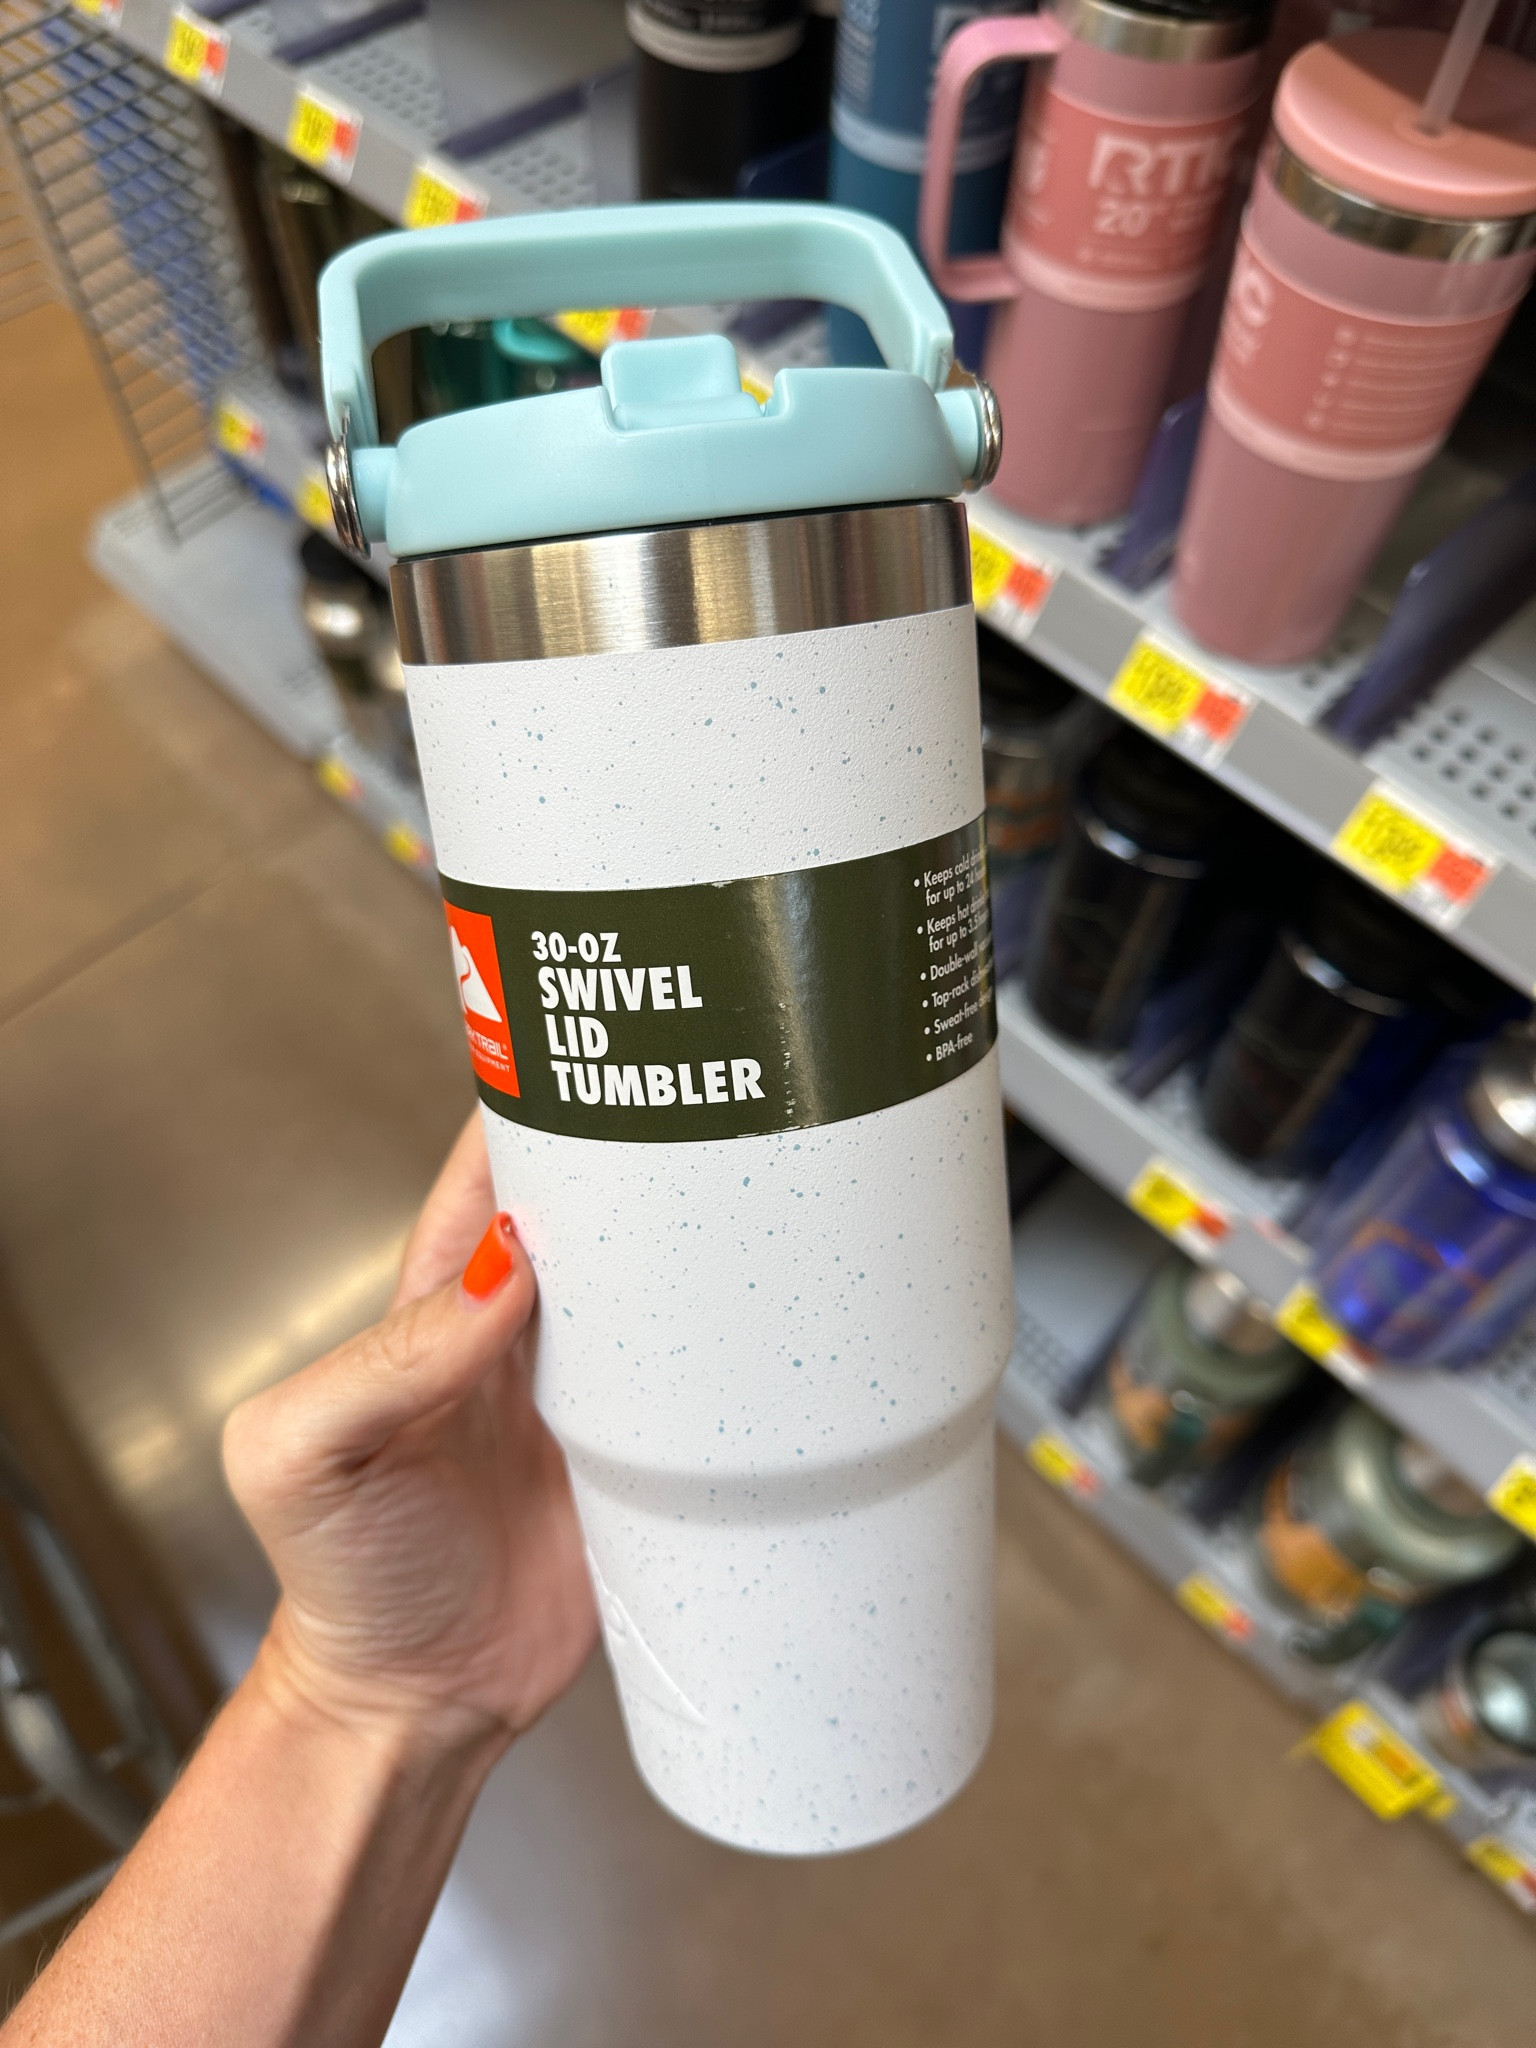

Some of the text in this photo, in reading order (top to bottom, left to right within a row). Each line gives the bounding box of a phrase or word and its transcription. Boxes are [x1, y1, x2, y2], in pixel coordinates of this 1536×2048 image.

[923, 867, 953, 888] Keeps
[954, 853, 970, 875] cold
[926, 889, 941, 906] for
[943, 886, 955, 902] up
[956, 880, 964, 894] to
[965, 870, 974, 888] 24
[927, 913, 956, 935] Keeps
[957, 904, 969, 921] hot
[929, 935, 944, 953] for
[946, 931, 957, 948] up
[959, 926, 967, 939] to
[968, 914, 978, 933] 3.5
[531, 931, 622, 963] 30-OZ
[930, 940, 978, 980] Double-wall
[537, 965, 703, 1011] SWIVEL
[931, 975, 970, 1008] Top-rack
[934, 1001, 978, 1034] Sweat-free
[544, 1013, 609, 1059] LID
[936, 1032, 973, 1061] BPA-free
[550, 1058, 766, 1107] TUMBLER
